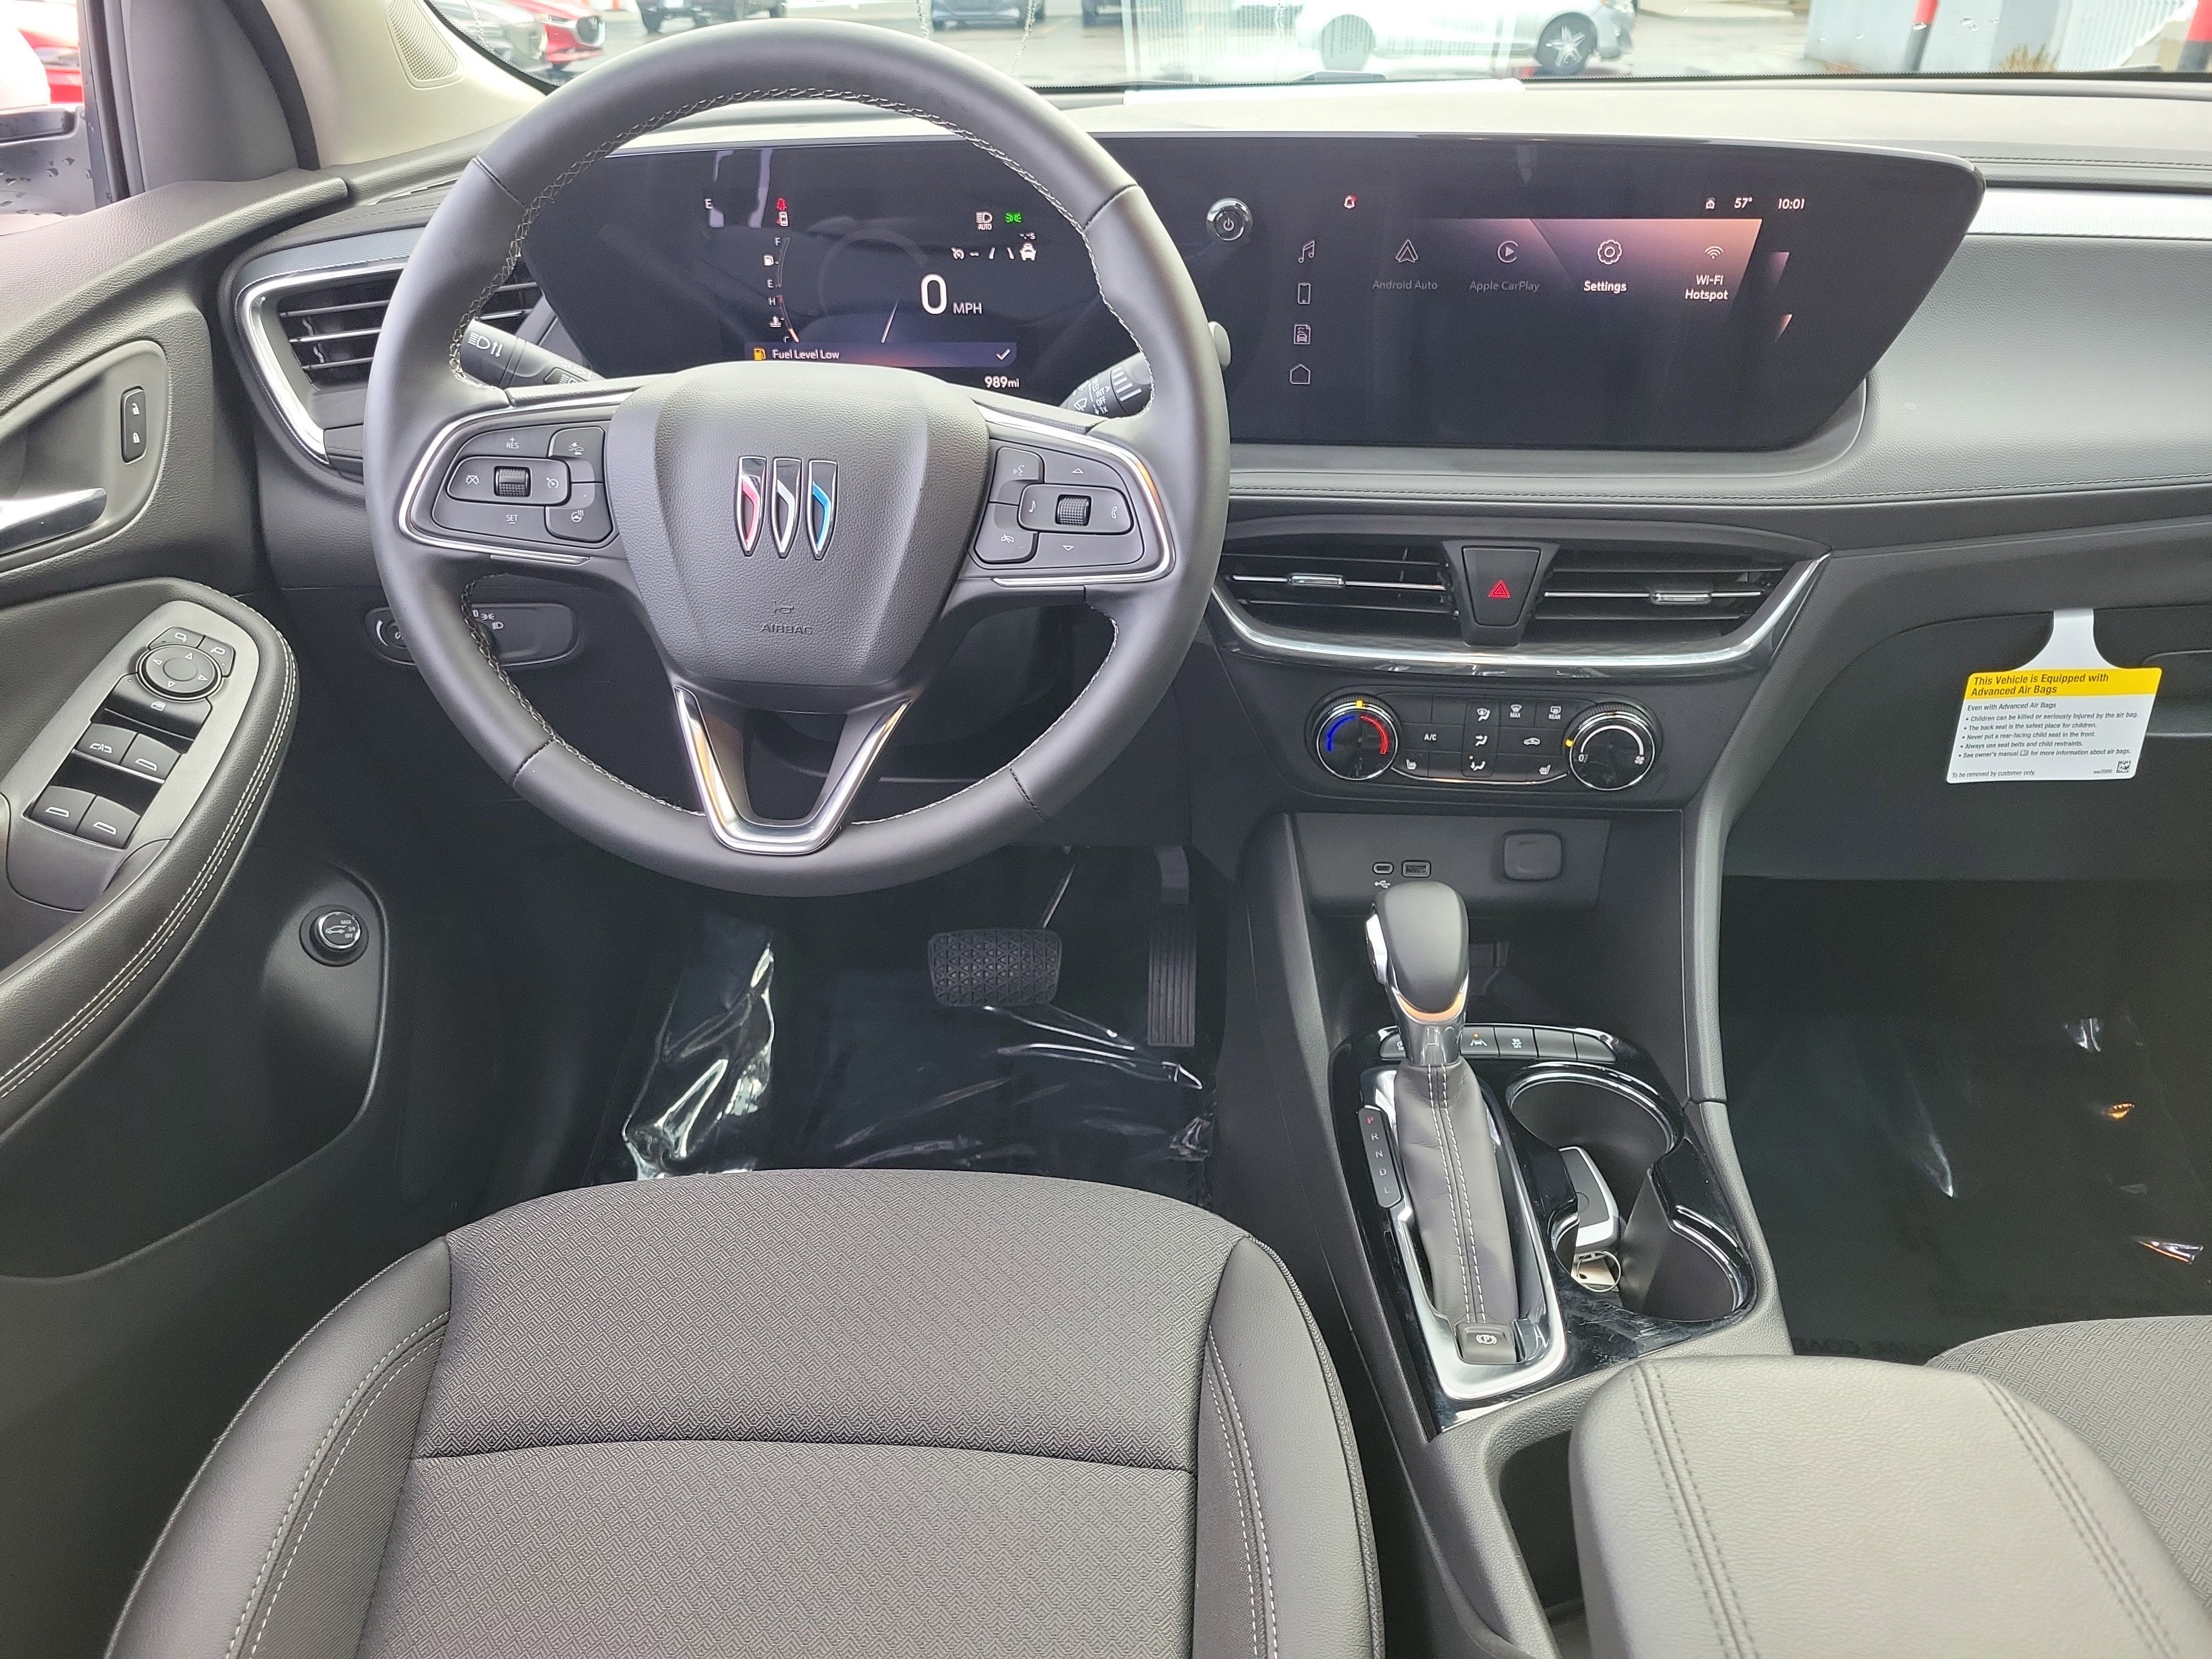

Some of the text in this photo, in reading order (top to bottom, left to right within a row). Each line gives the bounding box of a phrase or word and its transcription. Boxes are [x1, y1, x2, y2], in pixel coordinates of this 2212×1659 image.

[704, 198, 713, 209] E
[1734, 197, 1753, 209] 57°
[1778, 198, 1805, 210] 10:01
[774, 237, 781, 246] F
[767, 279, 774, 288] E
[1372, 280, 1438, 290] Android Auto
[1696, 274, 1724, 286] Wi-Fi
[1469, 280, 1540, 293] Apple CarPlay
[1583, 280, 1627, 294] Settings
[921, 273, 983, 314] 0 MPH
[1685, 289, 1729, 302] Hotspot
[768, 297, 776, 306] H
[771, 348, 840, 359] Fuel Level Low
[1096, 387, 1105, 398] INT
[1096, 396, 1107, 407] OFF
[761, 623, 813, 635] AIRBAG
[1974, 673, 2109, 686] This Vehicle is Equipped with
[1971, 685, 2057, 696] Advanced Air Bags
[1424, 733, 1437, 741] A/C
[1375, 1150, 1384, 1158] N
[1379, 1168, 1387, 1176] D
